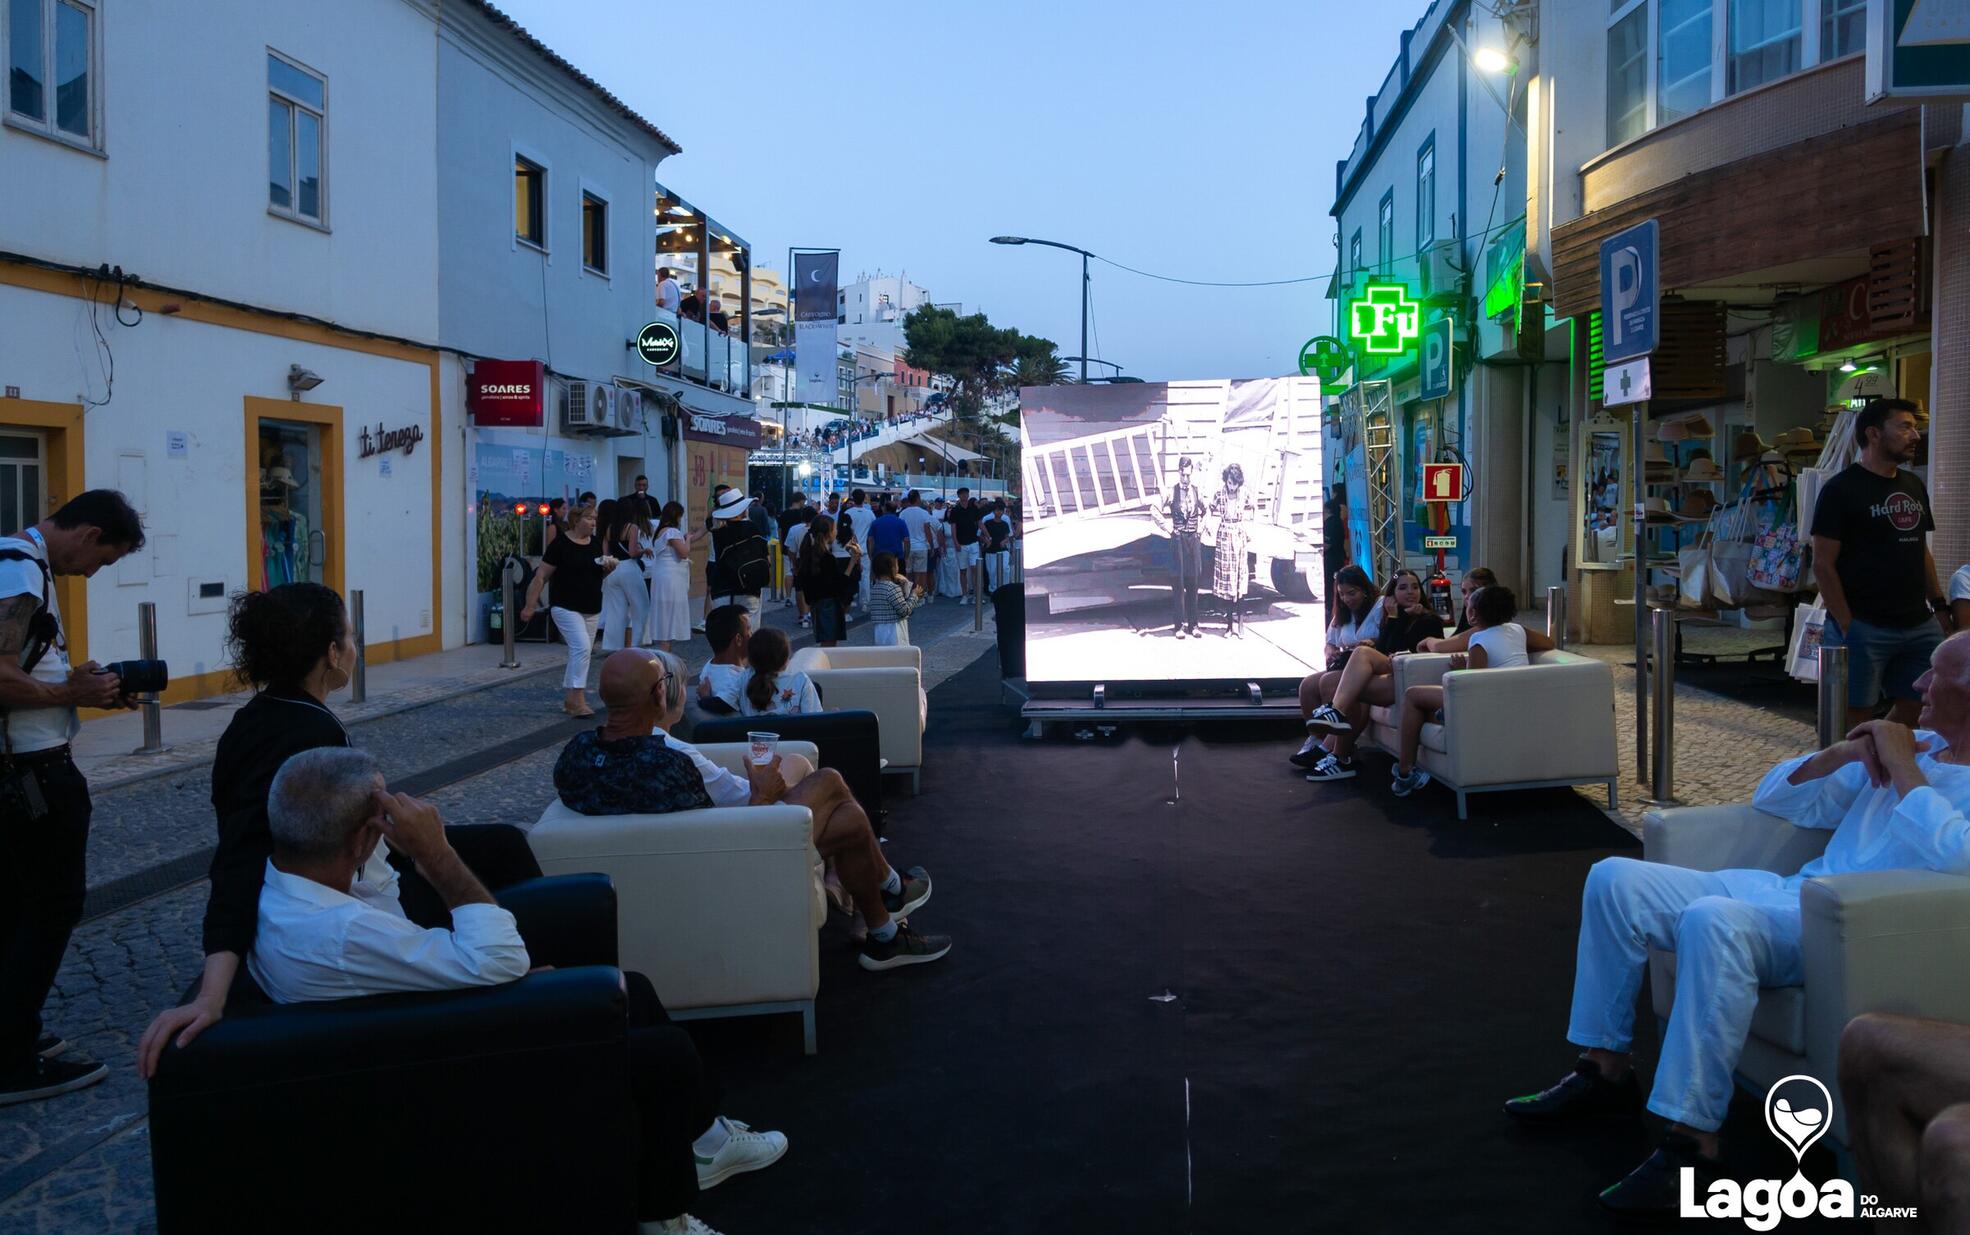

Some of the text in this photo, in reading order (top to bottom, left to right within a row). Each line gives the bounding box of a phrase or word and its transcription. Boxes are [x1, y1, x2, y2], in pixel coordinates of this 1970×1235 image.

[1611, 246, 1642, 346] P
[1425, 331, 1443, 391] P
[480, 385, 531, 393] SOARES
[690, 415, 727, 436] SOARES
[1870, 500, 1901, 518] Hard
